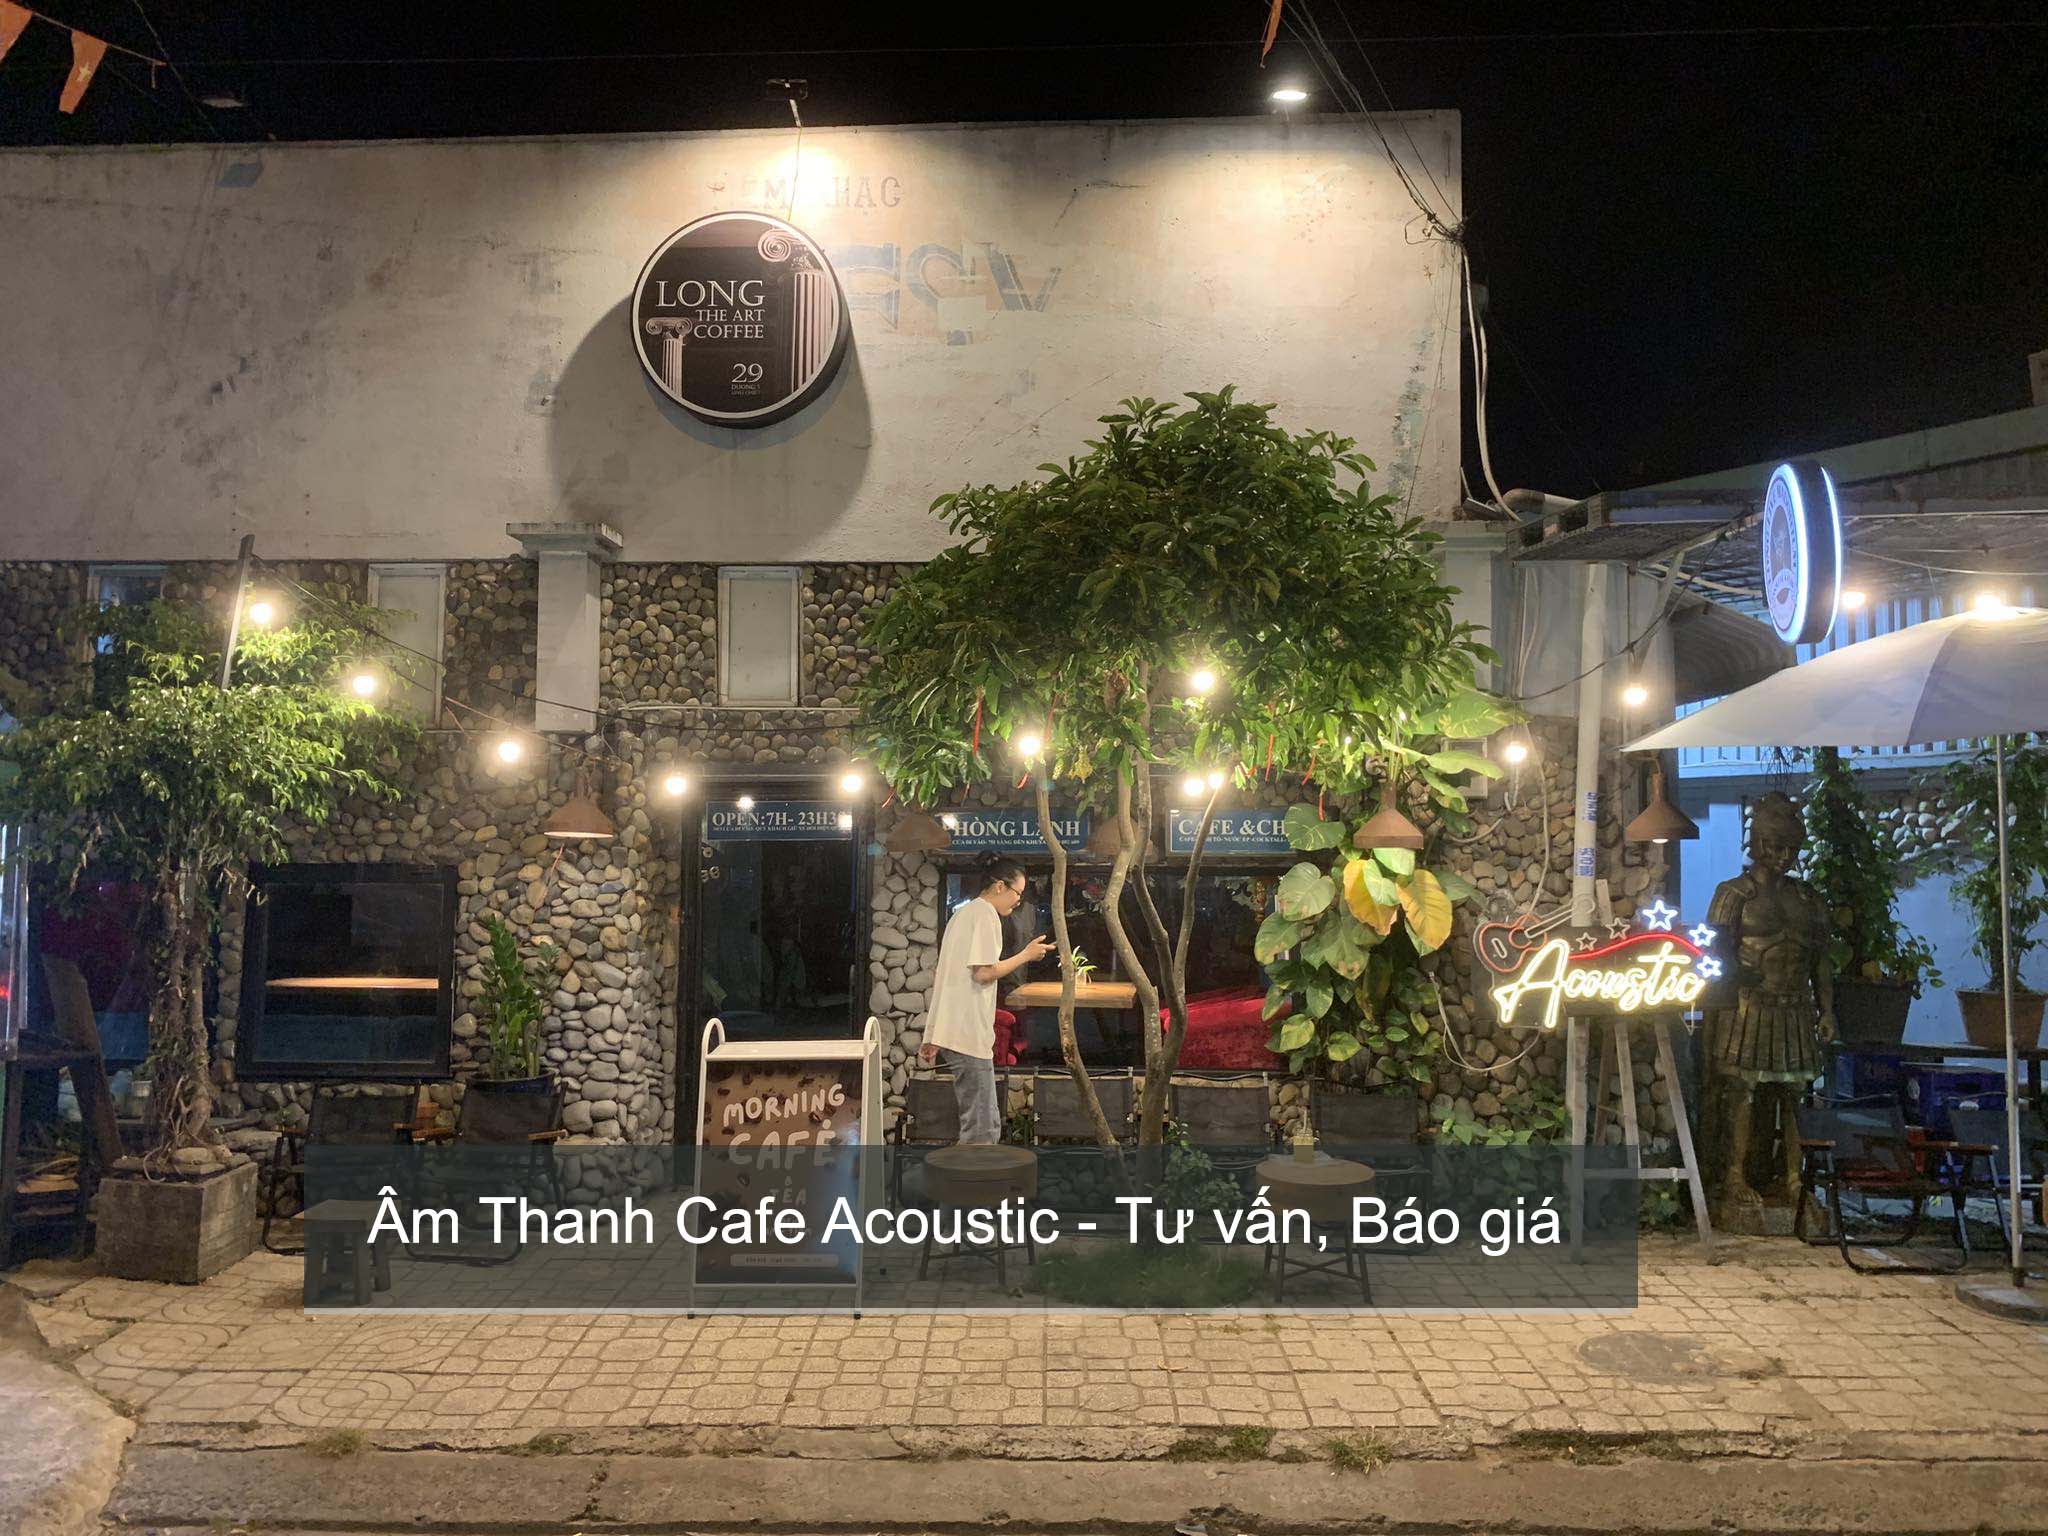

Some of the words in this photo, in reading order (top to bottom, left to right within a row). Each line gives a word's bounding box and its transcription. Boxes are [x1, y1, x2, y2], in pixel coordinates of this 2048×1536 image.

[655, 279, 766, 307] LONG
[695, 309, 728, 322] THE
[732, 309, 766, 322] ART
[693, 324, 765, 339] COFFEE
[731, 362, 764, 383] 29
[797, 811, 852, 827] 23H3
[943, 816, 1016, 837] HÒNG
[1493, 938, 1706, 1028] Acoustic
[724, 1084, 845, 1127] MORNING
